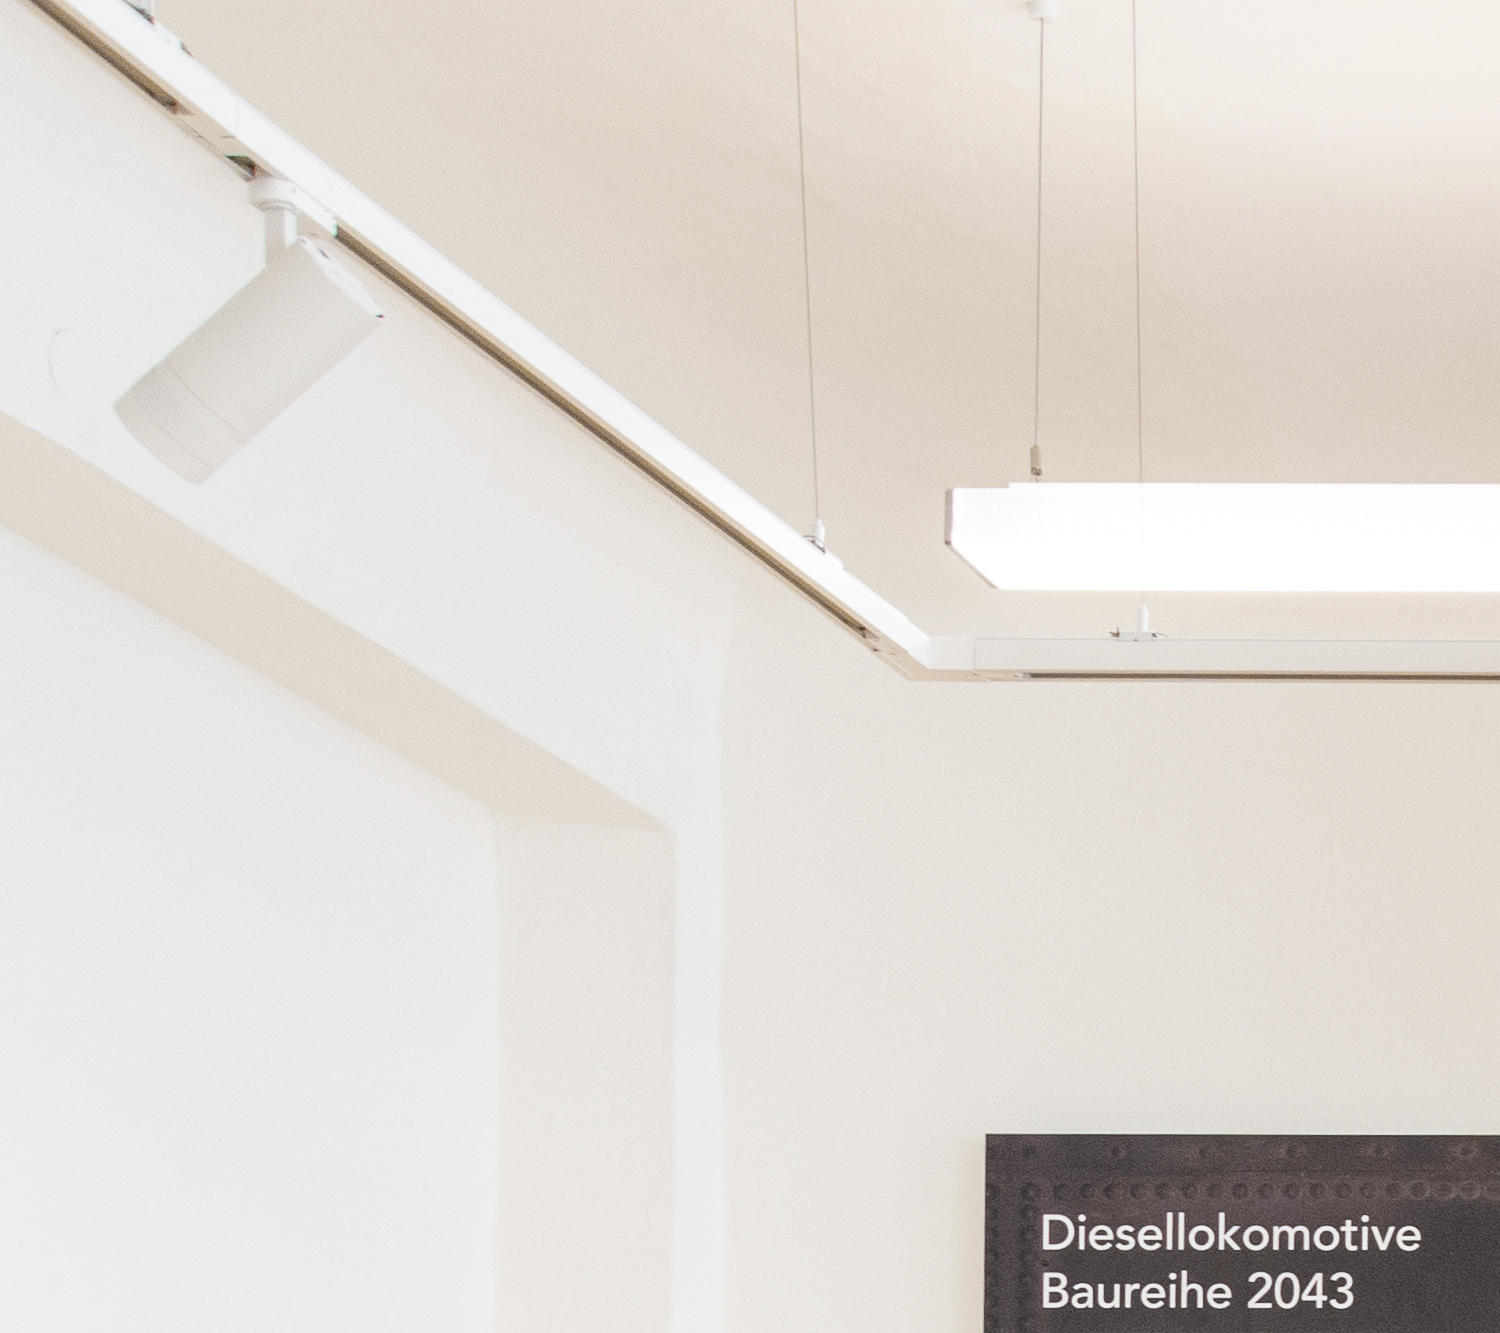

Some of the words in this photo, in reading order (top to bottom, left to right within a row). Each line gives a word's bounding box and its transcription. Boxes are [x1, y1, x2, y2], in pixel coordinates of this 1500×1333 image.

[1042, 1212, 1421, 1251] Diesellokomotive
[1043, 1270, 1232, 1309] Baureihe
[1248, 1272, 1354, 1309] 2043
